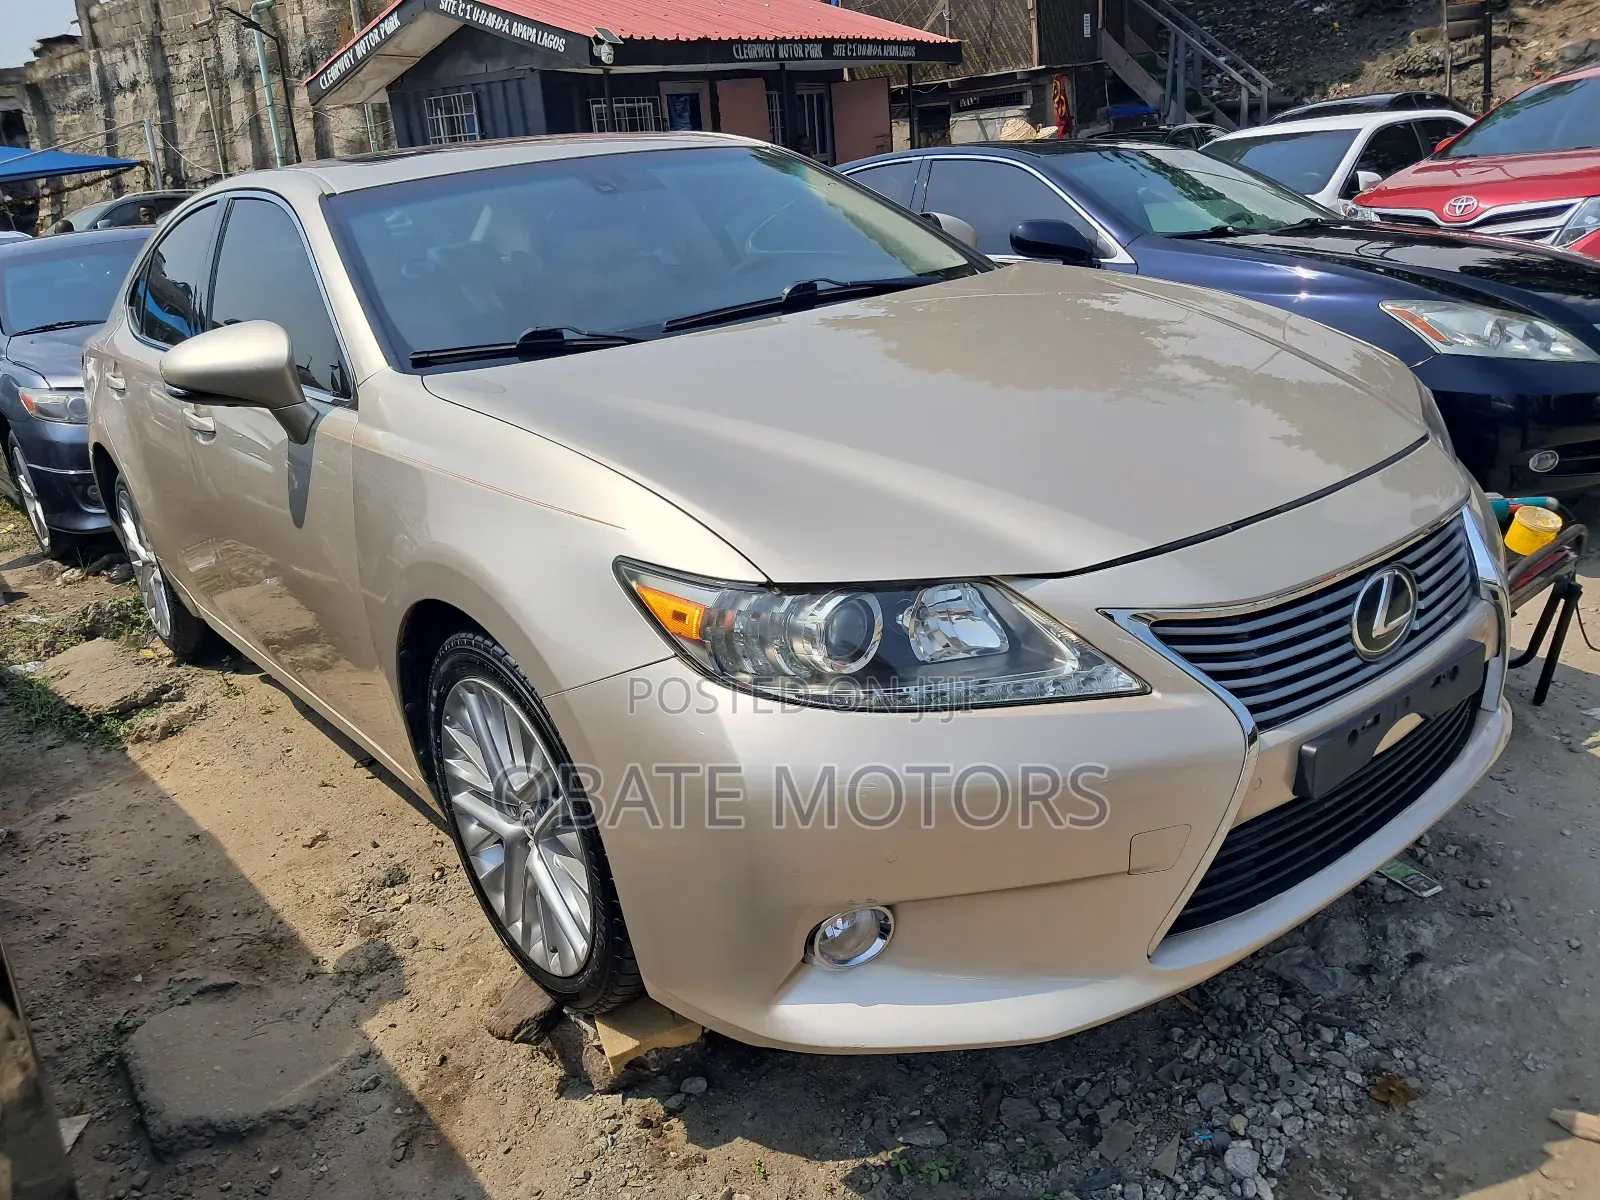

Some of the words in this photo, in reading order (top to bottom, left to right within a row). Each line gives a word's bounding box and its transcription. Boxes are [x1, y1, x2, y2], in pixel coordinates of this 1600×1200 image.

[319, 48, 355, 90] CLEARWAY
[354, 28, 381, 60] MOTOR
[379, 11, 401, 40] PARK
[439, 0, 457, 15] SITE
[511, 21, 537, 43] APAPA
[537, 30, 566, 53] LAGOS
[732, 43, 776, 60] CLEARWAY
[778, 43, 804, 58] MOTOR
[804, 43, 824, 59] PARK
[832, 43, 846, 57] SITE
